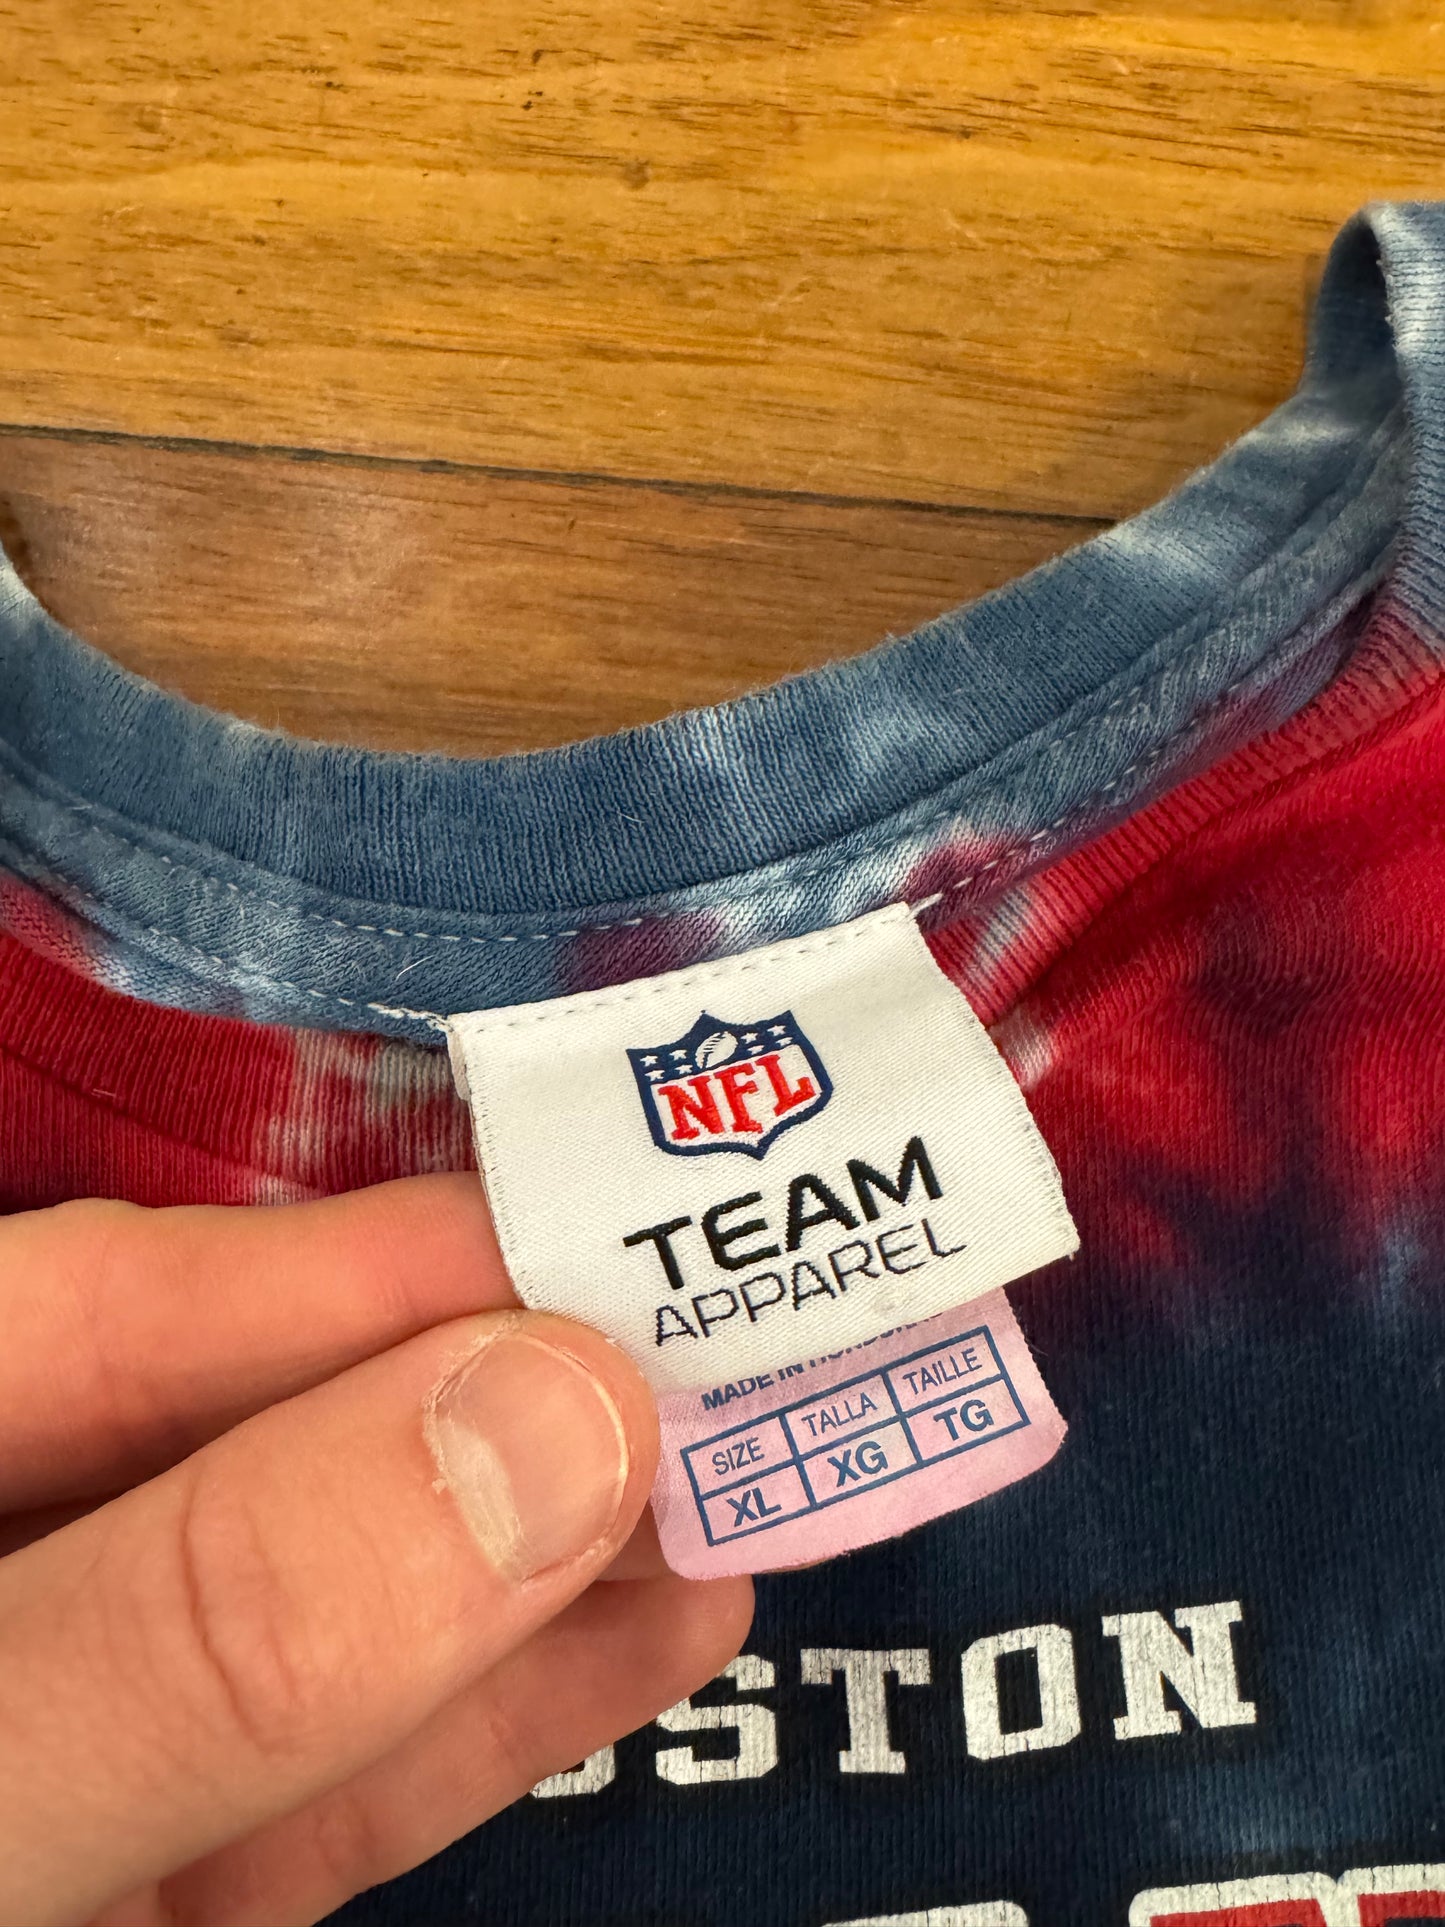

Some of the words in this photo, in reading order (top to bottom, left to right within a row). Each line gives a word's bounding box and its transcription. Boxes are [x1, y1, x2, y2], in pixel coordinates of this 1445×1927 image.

[657, 1053, 817, 1140] NFL
[622, 1135, 944, 1290] TEAM
[655, 1217, 968, 1347] APPAREL
[700, 1374, 775, 1410] MADE
[711, 1436, 766, 1476] SIZE
[801, 1392, 879, 1437] TALLA
[901, 1347, 984, 1396] TAILLE
[726, 1490, 782, 1528] XL
[826, 1440, 889, 1488] XG
[933, 1398, 996, 1441] TG
